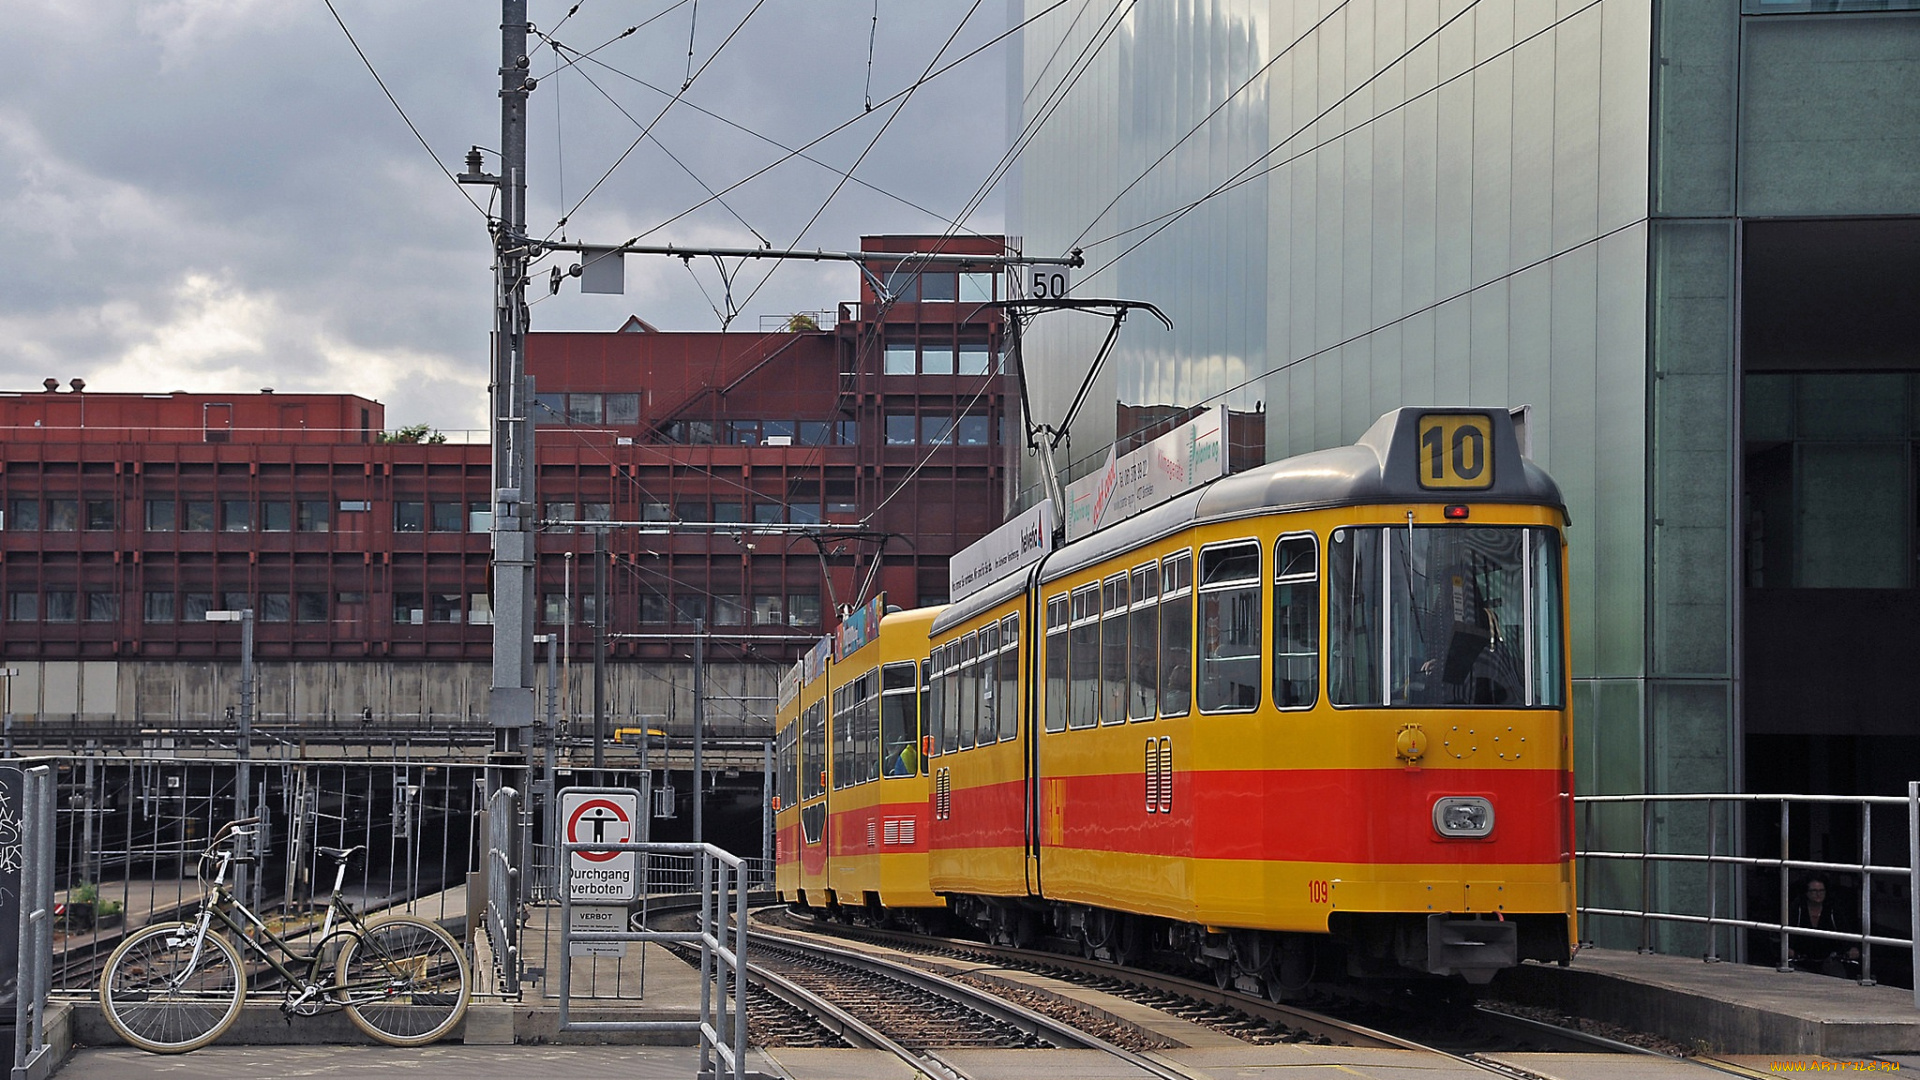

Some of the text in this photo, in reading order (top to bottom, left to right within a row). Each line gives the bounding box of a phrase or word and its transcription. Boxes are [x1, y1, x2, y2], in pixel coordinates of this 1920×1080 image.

[1033, 272, 1065, 299] 50
[1422, 425, 1484, 480] 10
[571, 882, 623, 894] verboten
[1308, 880, 1328, 903] 109
